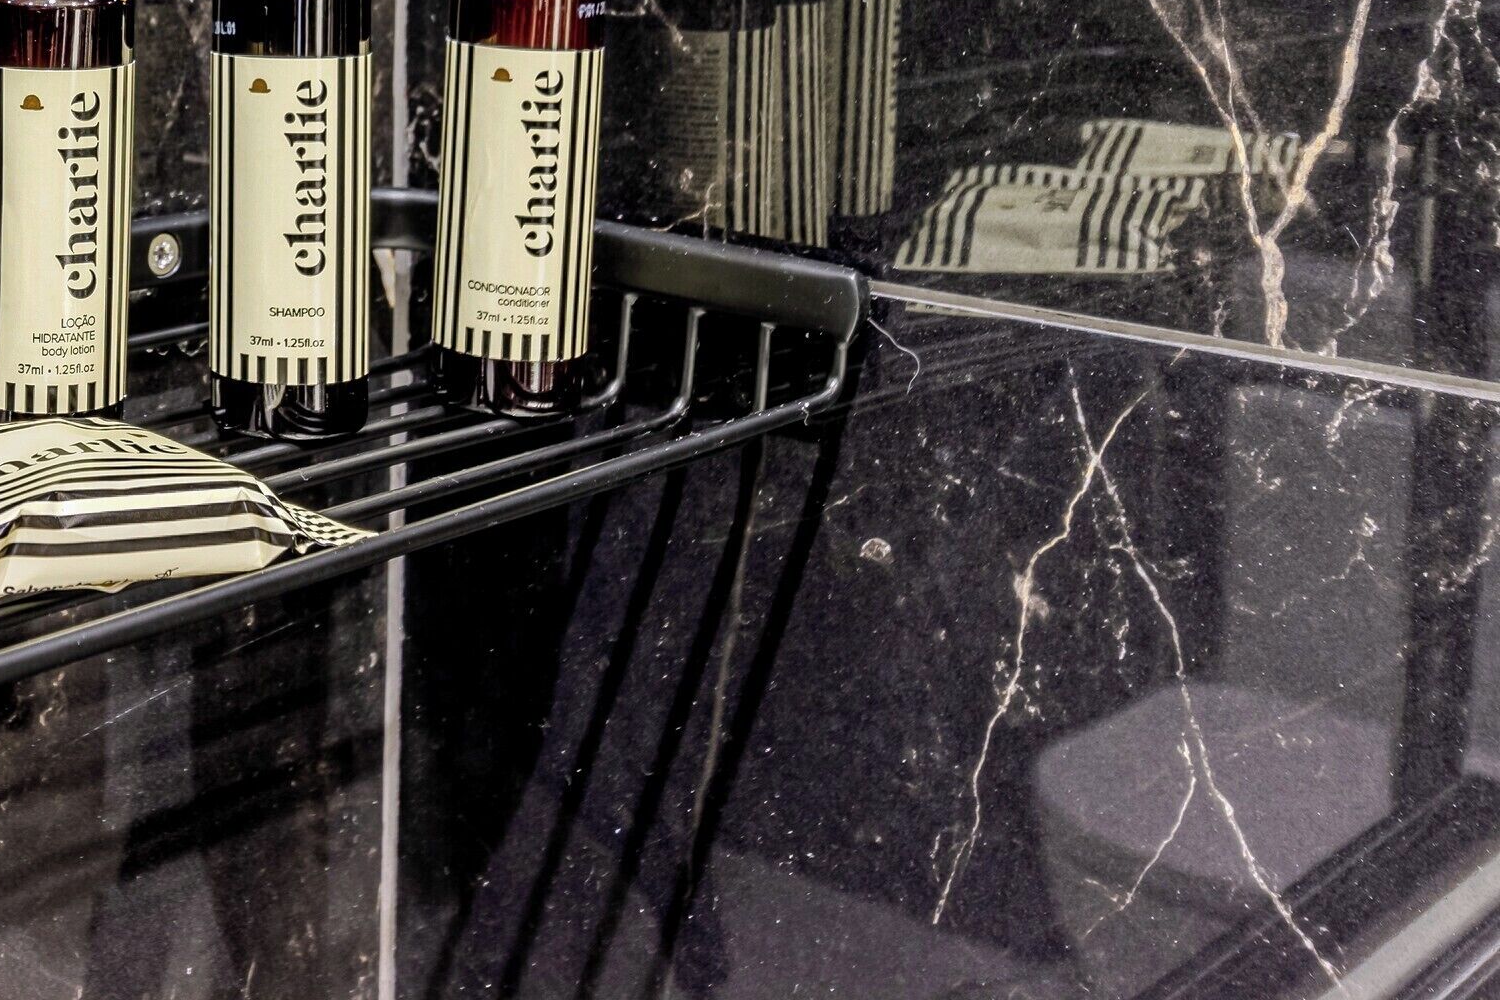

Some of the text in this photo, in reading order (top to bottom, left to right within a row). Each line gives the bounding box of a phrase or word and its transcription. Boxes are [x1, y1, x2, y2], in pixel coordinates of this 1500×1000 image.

[515, 69, 564, 258] charlie
[283, 79, 328, 277] charlie
[55, 91, 100, 299] charlie
[467, 280, 551, 297] CONDICIONADOR
[497, 298, 551, 308] conditioner
[269, 306, 326, 318] SHAMPOO
[476, 310, 500, 322] 37ml
[61, 314, 96, 330] LOÇÃO
[32, 330, 96, 344] HIDRATANTE
[249, 335, 274, 347] 37ml
[41, 345, 95, 358] body lotion
[17, 363, 44, 375] 37ml
